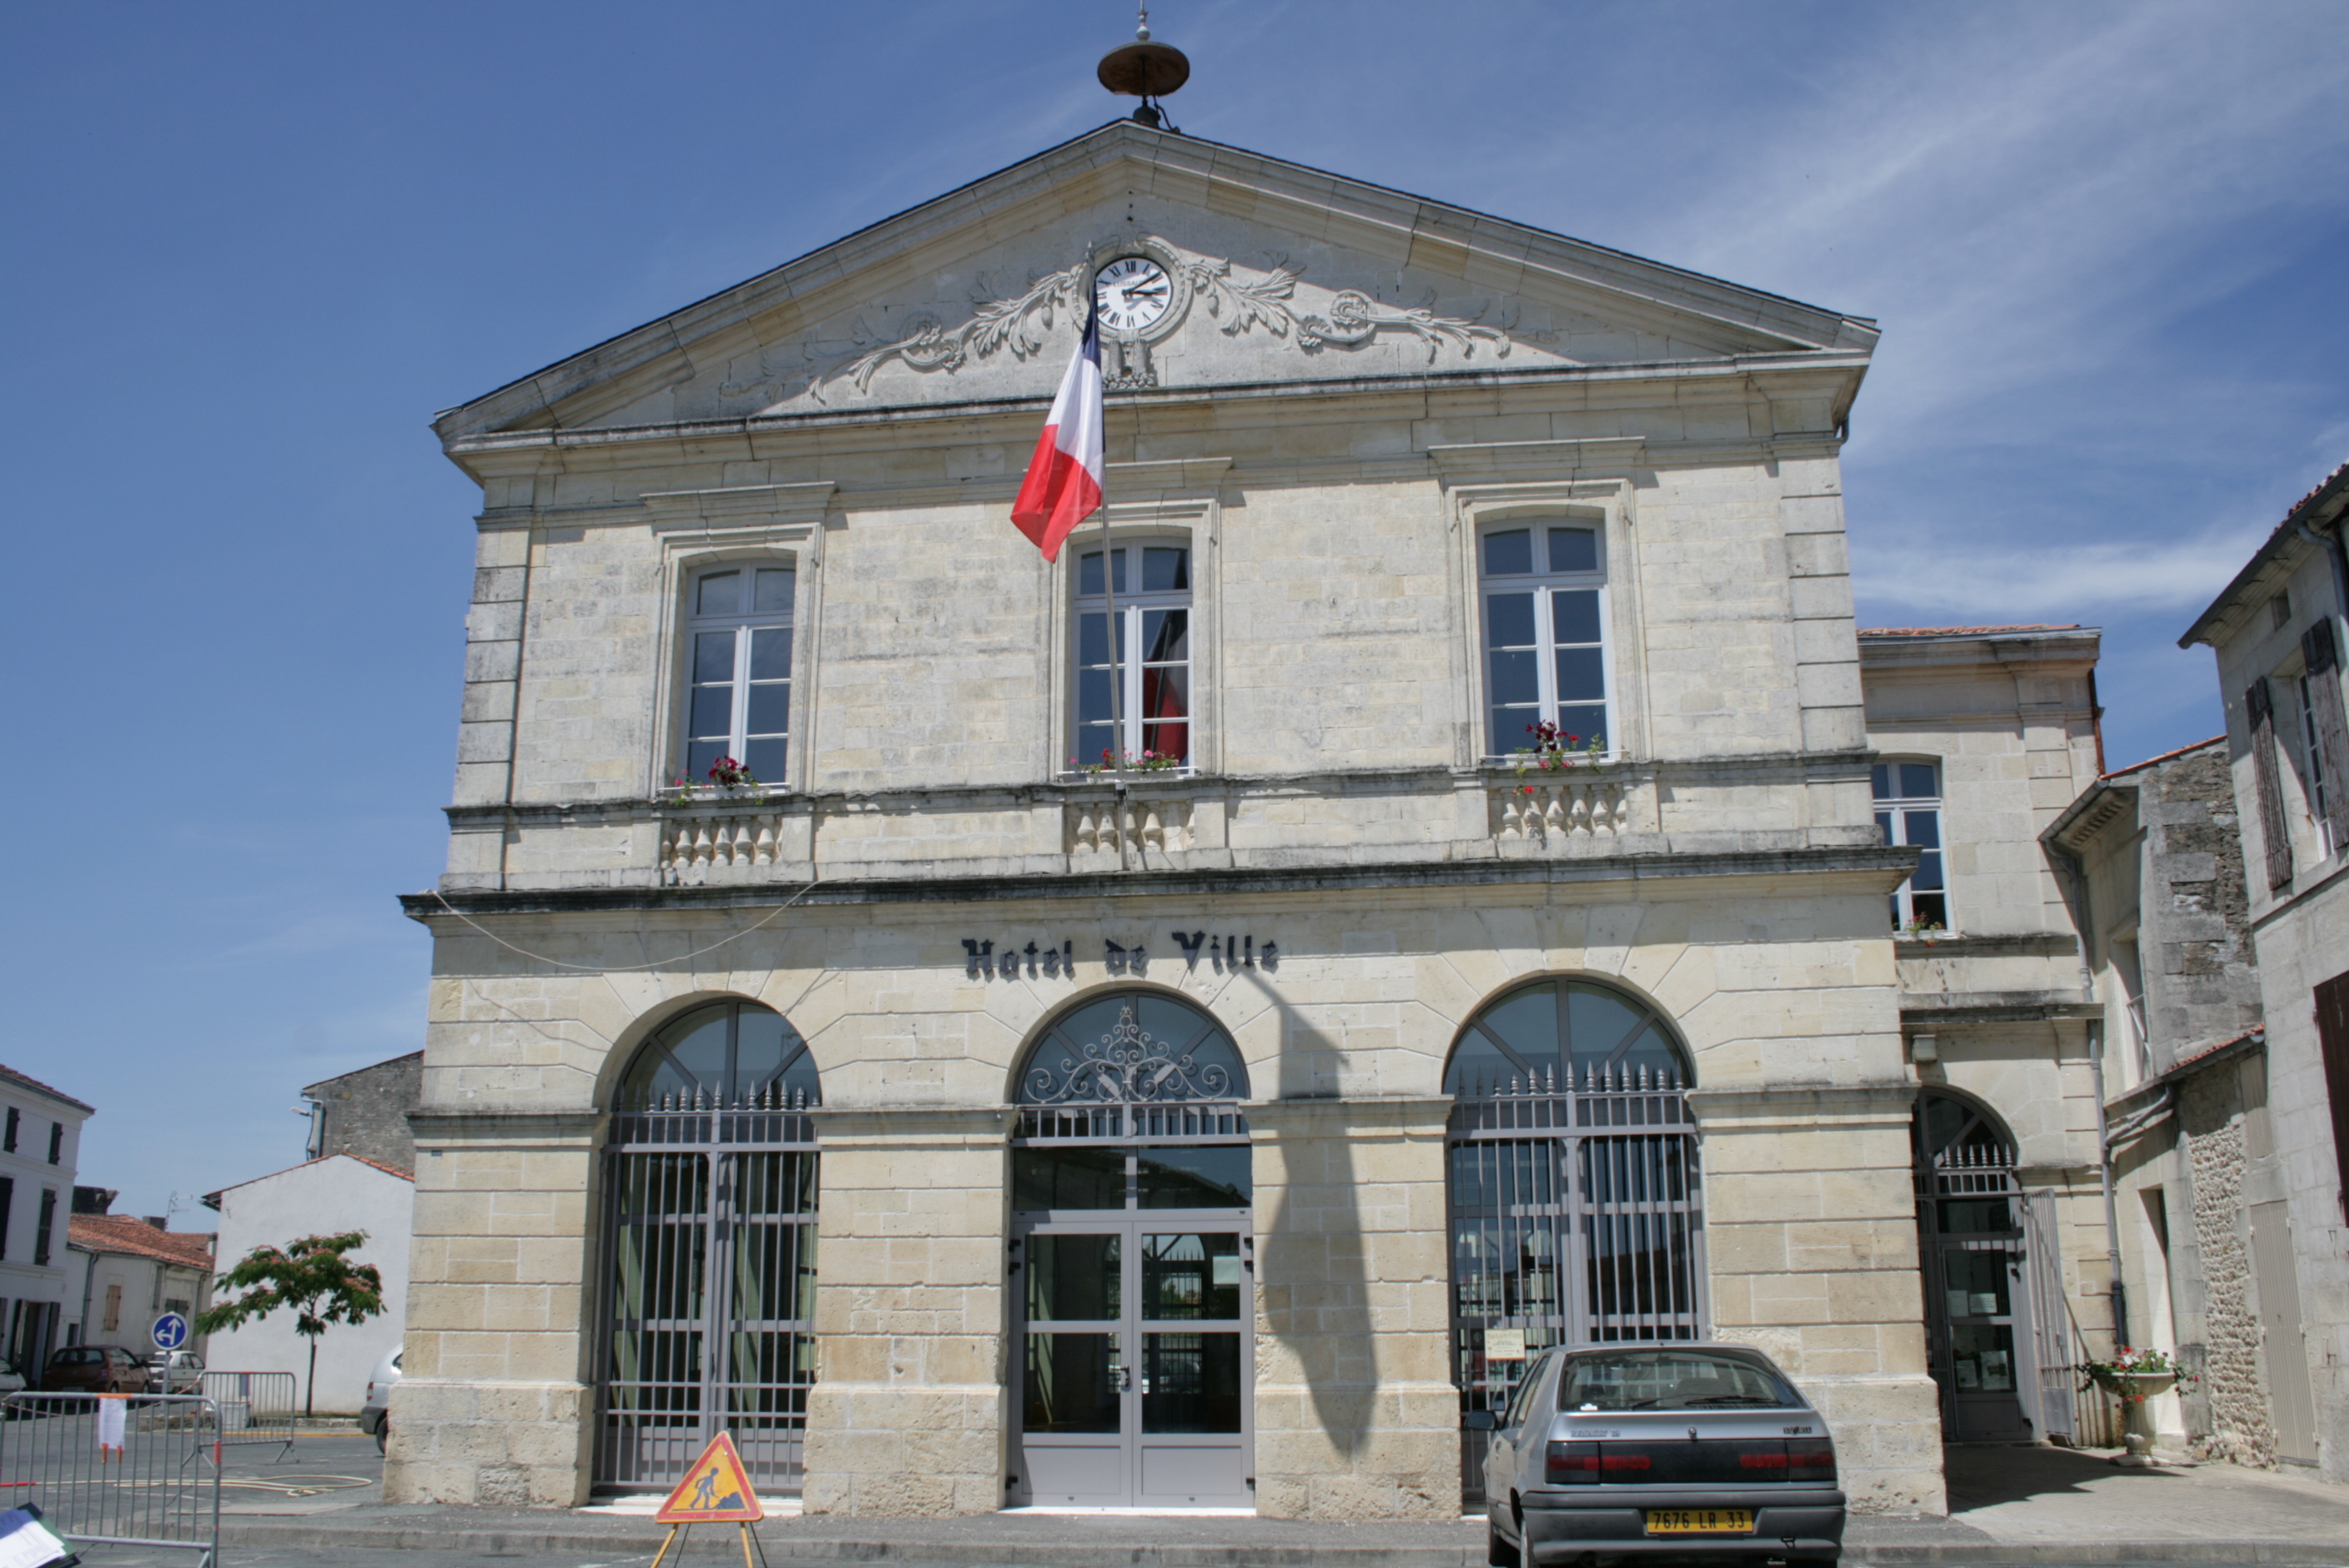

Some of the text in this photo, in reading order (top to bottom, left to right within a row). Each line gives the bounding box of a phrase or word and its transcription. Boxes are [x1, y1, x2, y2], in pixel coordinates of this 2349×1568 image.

[1104, 938, 1148, 971] de
[1171, 930, 1279, 971] Ville
[1653, 1510, 1744, 1529] 7676 LR 33
